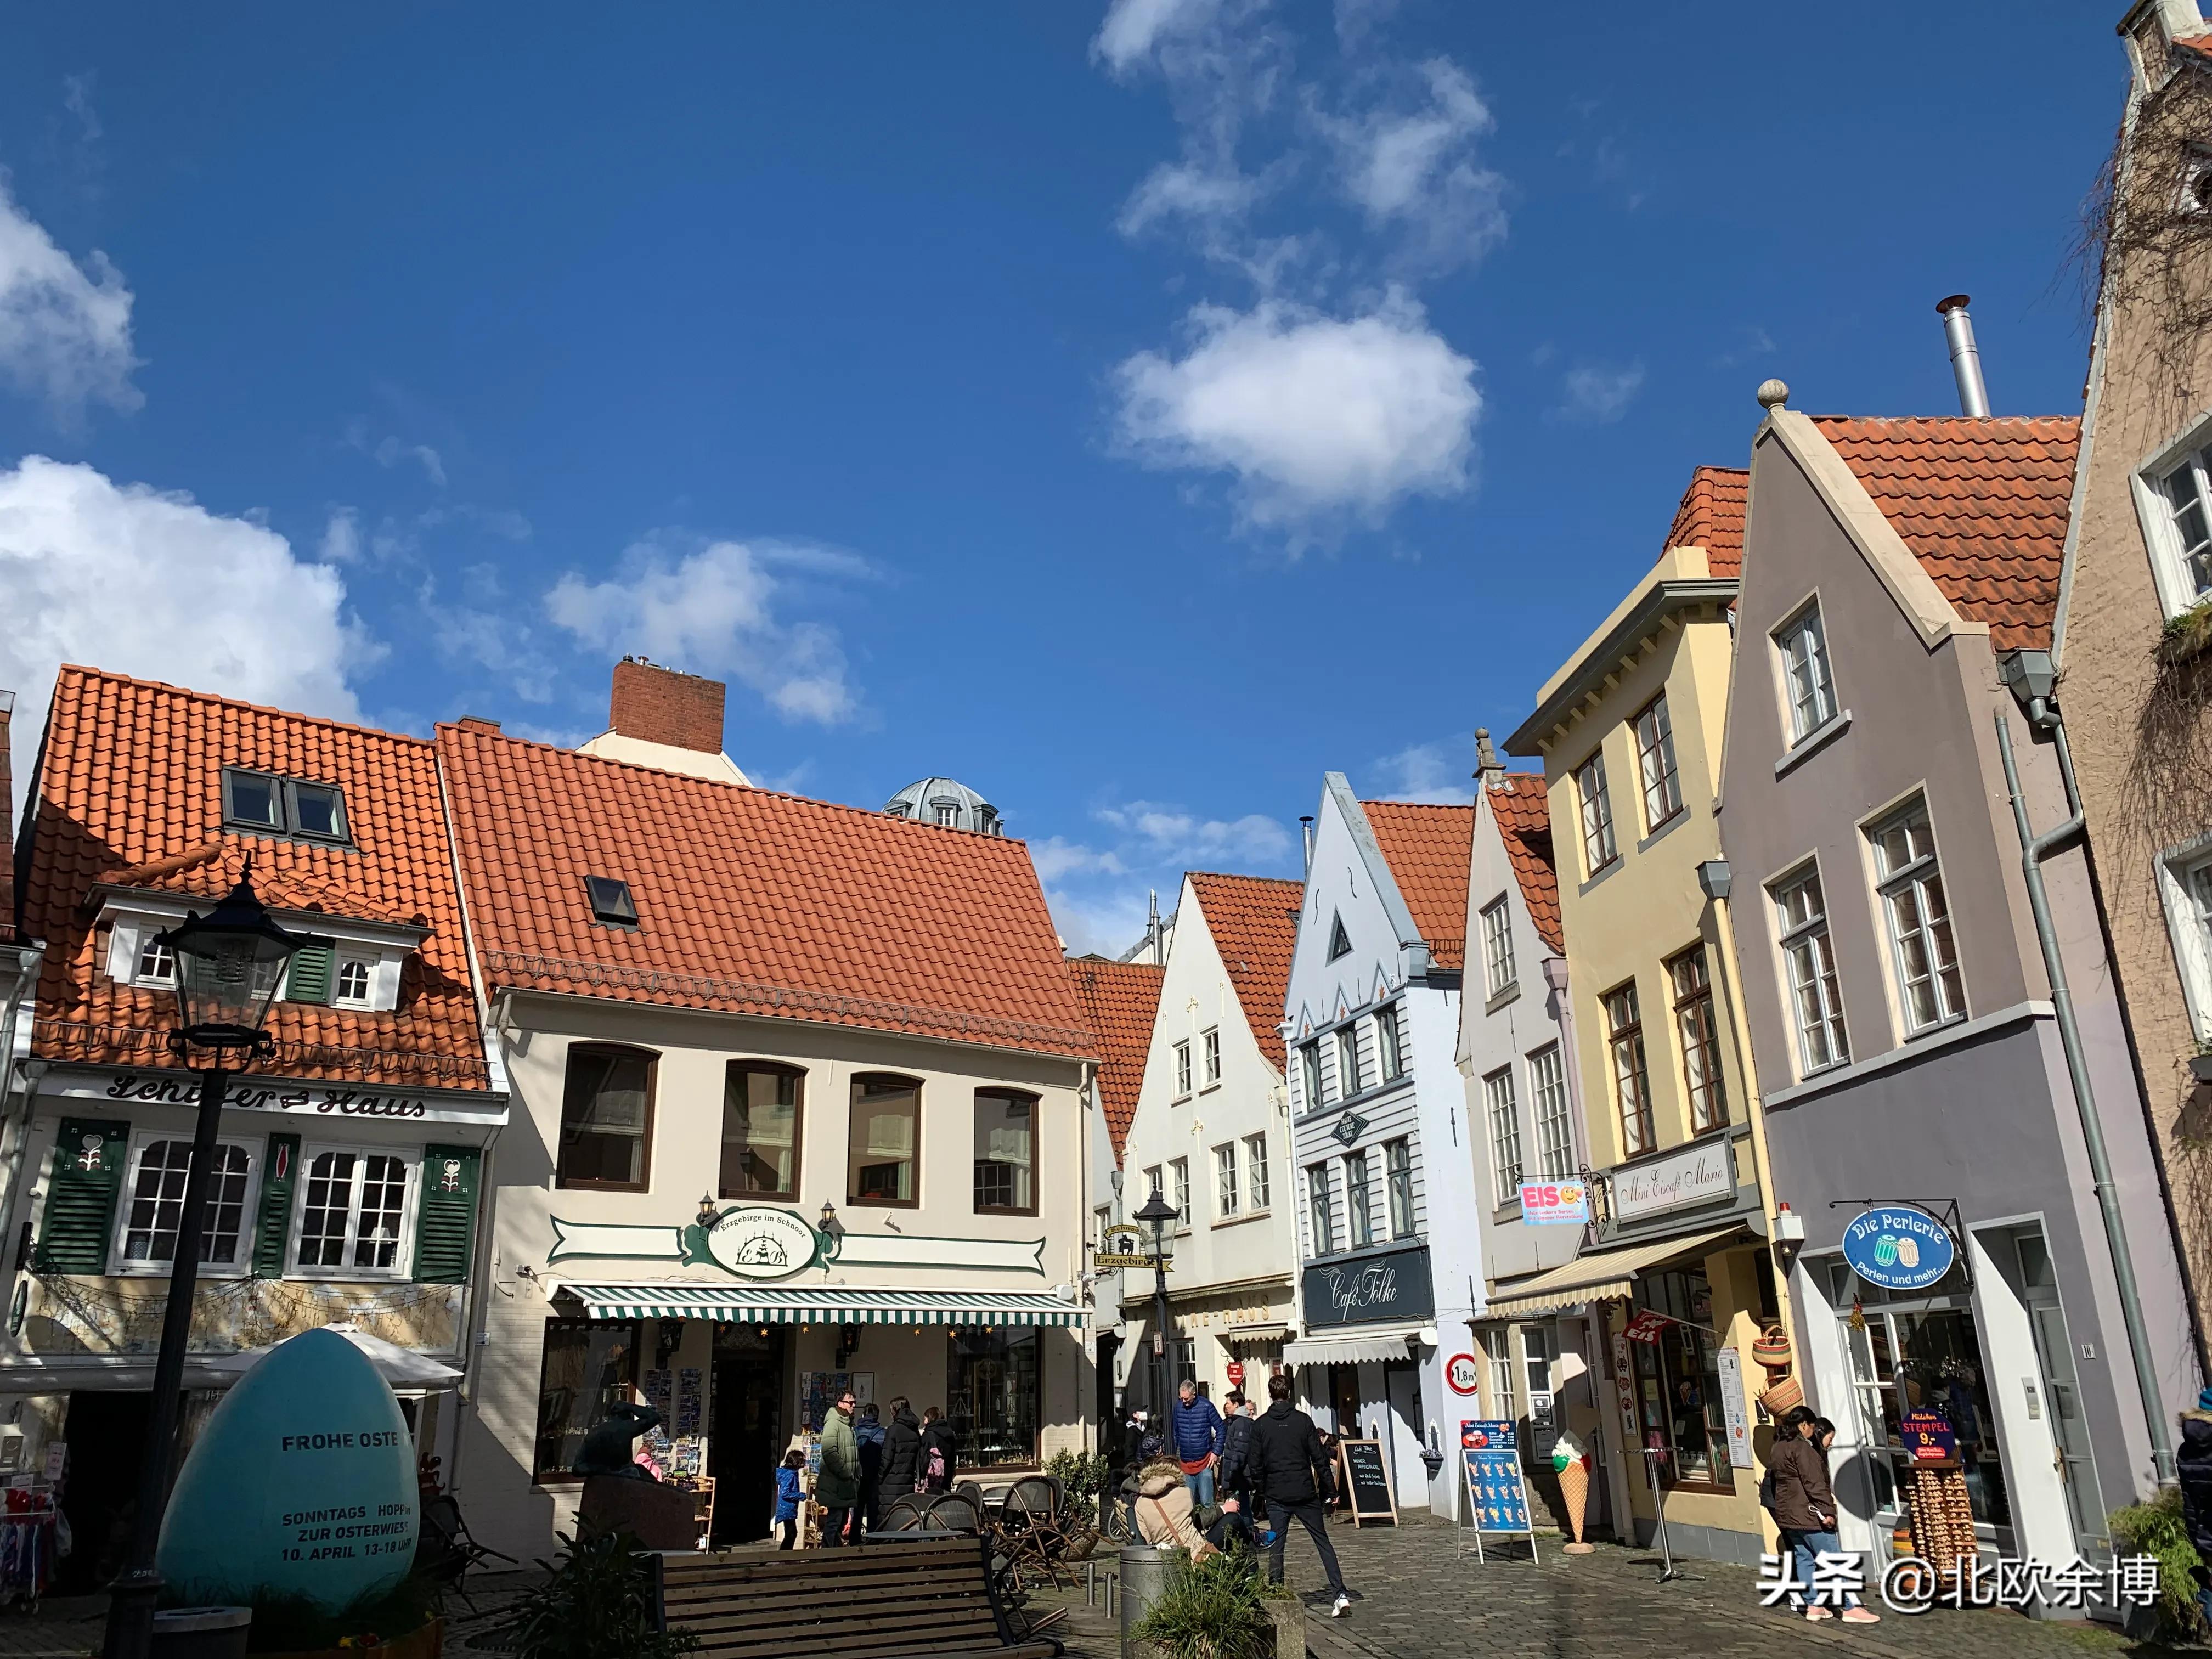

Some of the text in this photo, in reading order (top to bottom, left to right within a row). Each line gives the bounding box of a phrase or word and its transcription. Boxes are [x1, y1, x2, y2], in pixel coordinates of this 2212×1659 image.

[107, 1076, 425, 1118] Schier Haus
[1621, 1155, 1723, 1204] Mini Eiscafé Mario
[1522, 1186, 1560, 1208] EIS
[720, 1215, 762, 1232] Erzgebirge
[777, 1217, 806, 1238] Schnoor
[1852, 1214, 1944, 1244] Die Perlerie
[742, 1249, 783, 1263] E B
[1856, 1261, 1889, 1283] Perlen
[1892, 1274, 1912, 1284] und
[1319, 1257, 1397, 1321] Café Tölke
[1627, 1328, 1656, 1342] EIS
[2084, 1345, 2091, 1358] 10
[1903, 1423, 1950, 1432] STEMPEL
[282, 1433, 354, 1451] FROHE
[282, 1506, 366, 1526] SONNTAGS
[298, 1528, 331, 1542] ZUR
[282, 1538, 411, 1561] 10. APRIL 13-18 UHR
